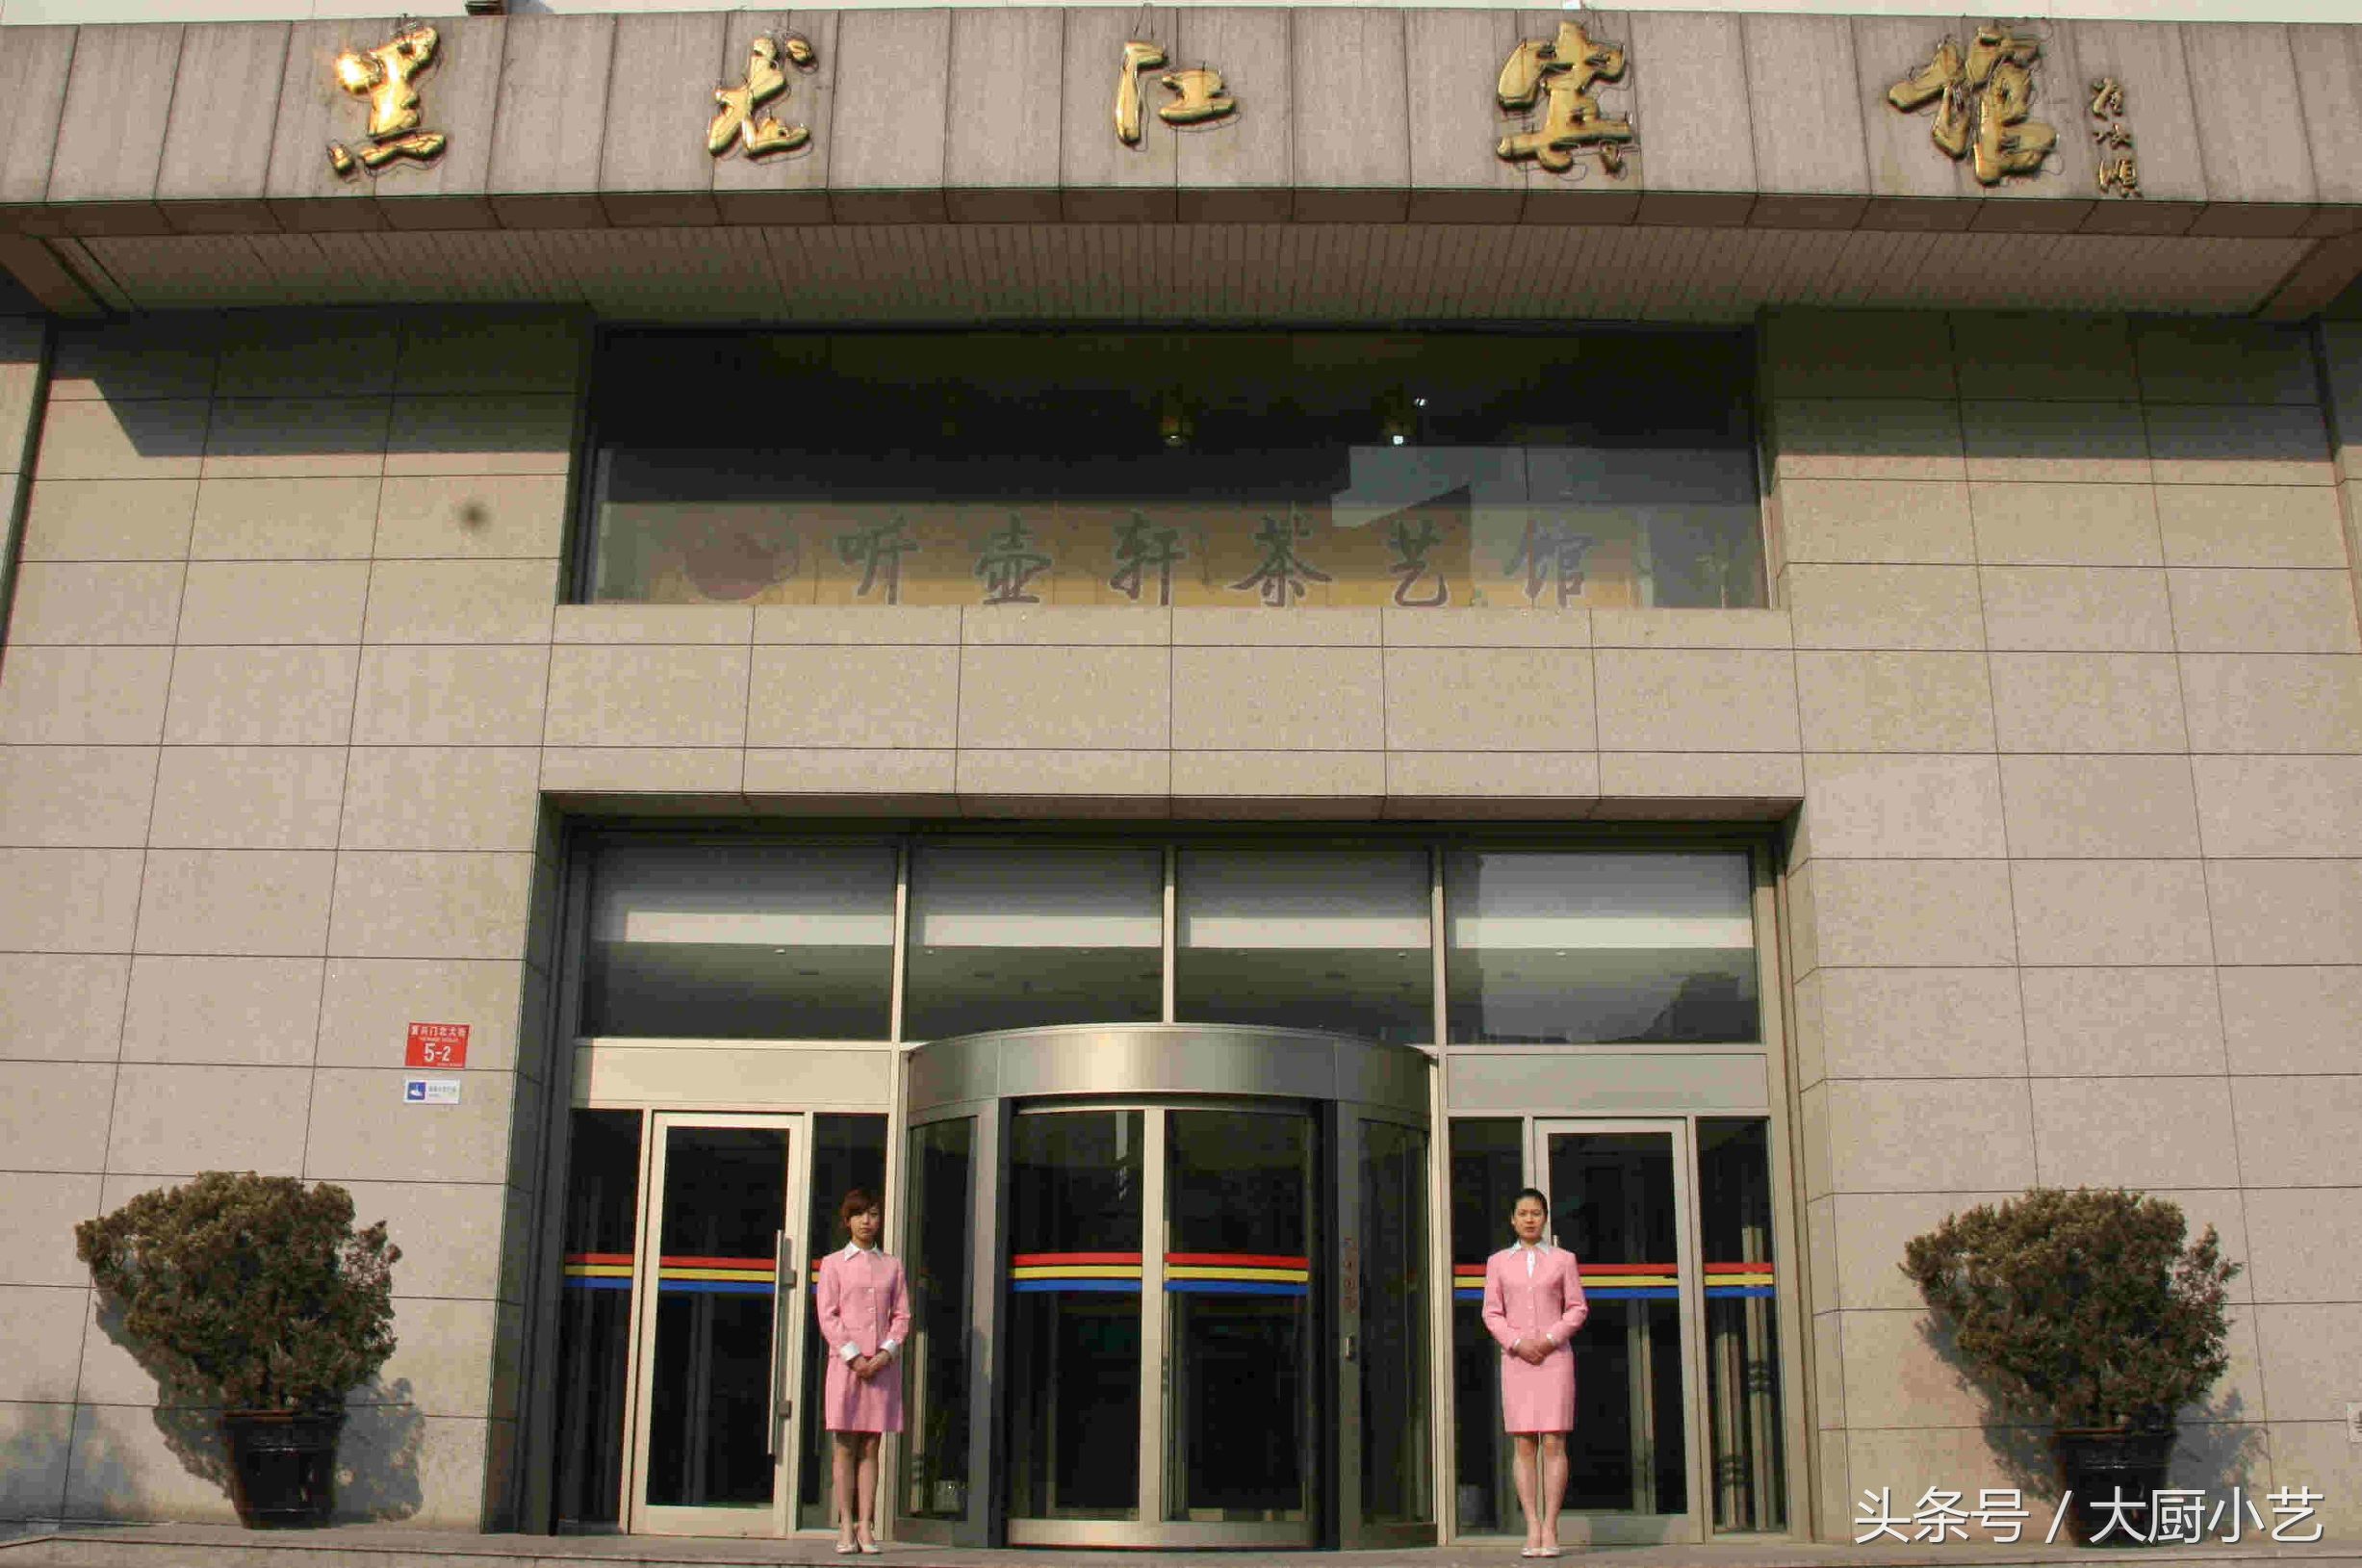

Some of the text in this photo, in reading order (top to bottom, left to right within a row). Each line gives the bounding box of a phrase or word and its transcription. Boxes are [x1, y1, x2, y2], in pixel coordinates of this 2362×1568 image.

[830, 510, 1592, 606] 听壶轩茶艺馆
[424, 1043, 450, 1062] 5-2
